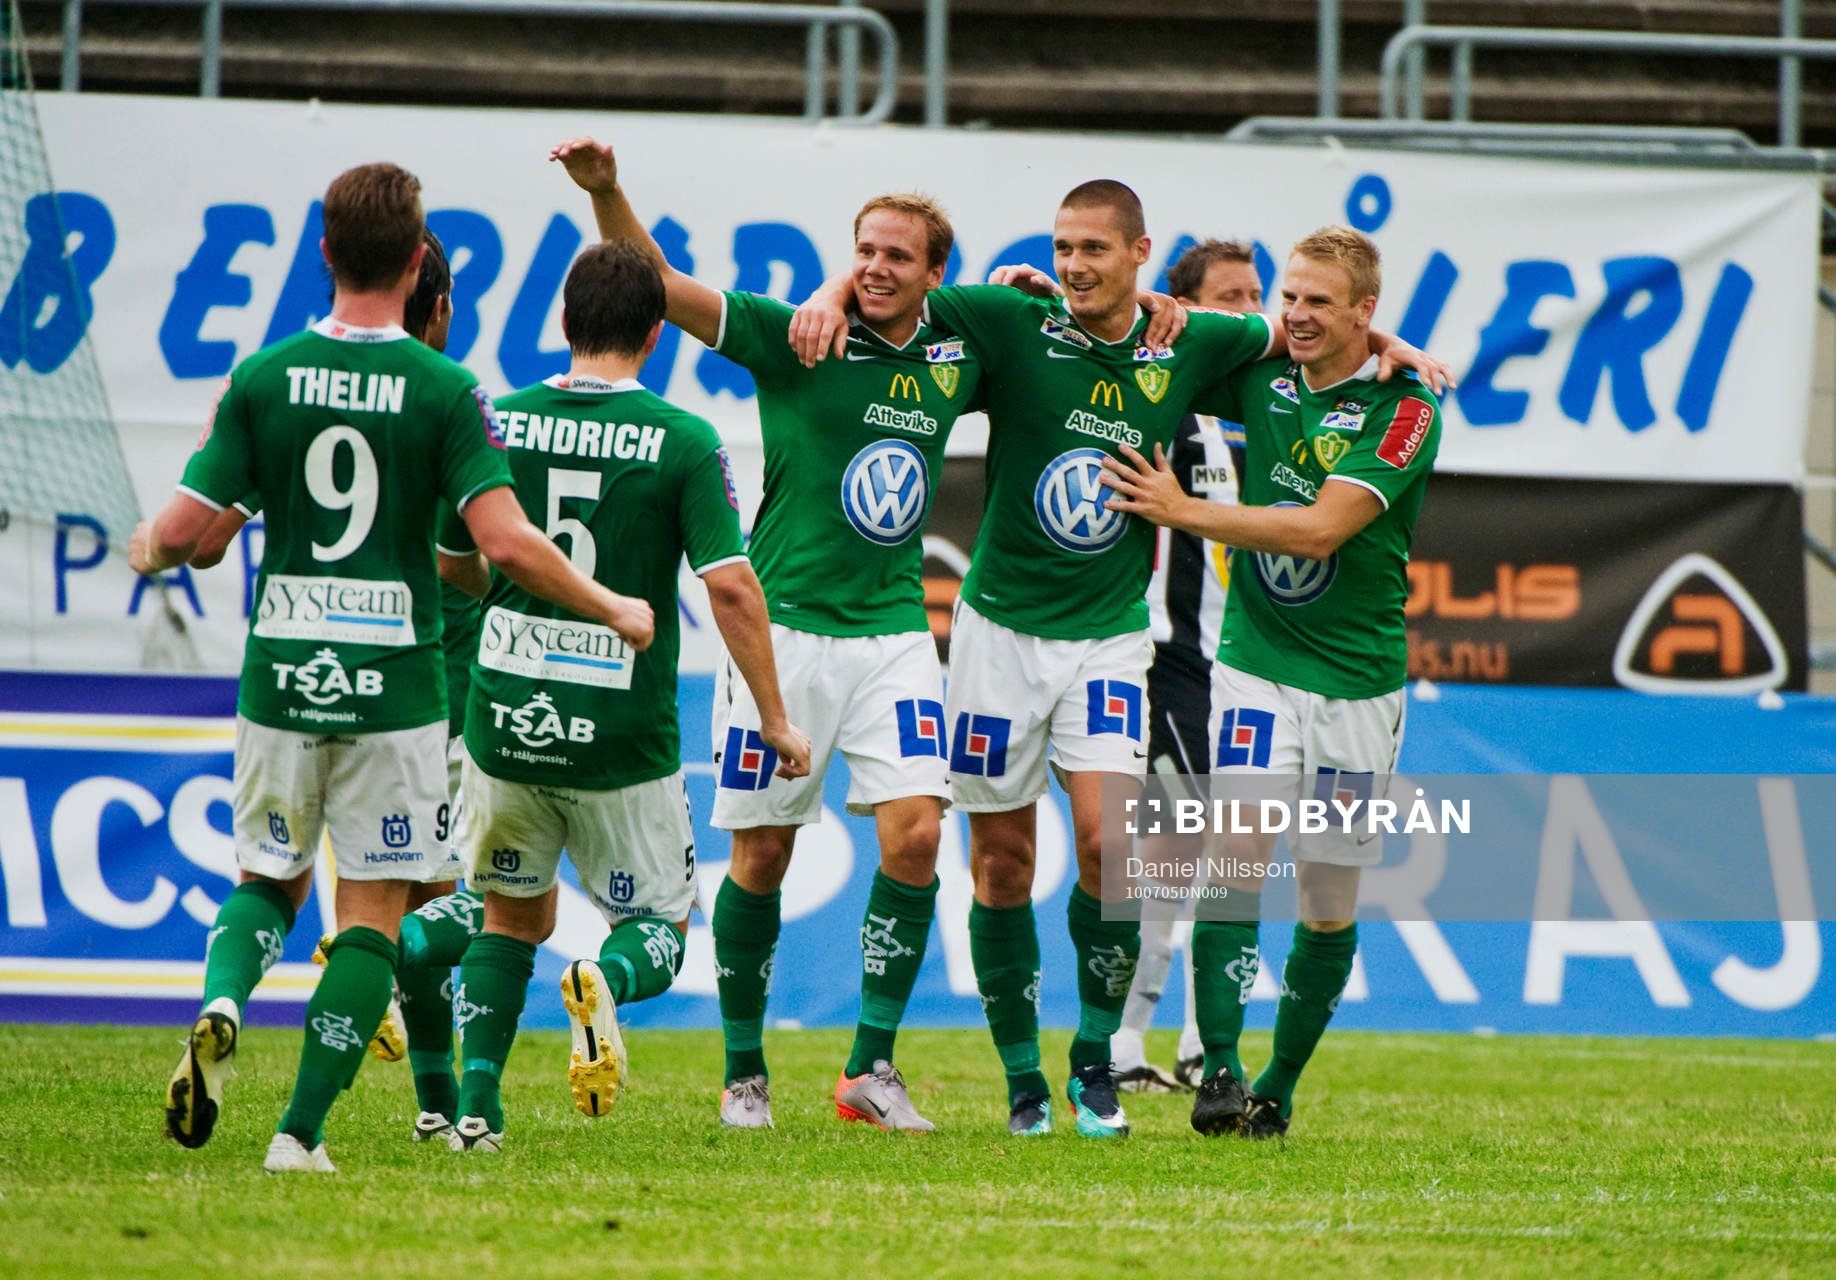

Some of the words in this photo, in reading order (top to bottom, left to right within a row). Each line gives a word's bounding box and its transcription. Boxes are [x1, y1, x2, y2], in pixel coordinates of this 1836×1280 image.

[286, 367, 406, 413] THELIN
[864, 403, 937, 435] Atteviks
[1066, 410, 1142, 448] Atteviks
[1398, 407, 1430, 463] Adecco
[304, 425, 379, 562] 9
[1194, 468, 1227, 483] MVB
[546, 467, 602, 590] 5
[272, 662, 384, 697] TSAB
[490, 702, 596, 744] TSAB
[502, 747, 513, 757] Er
[435, 802, 450, 842] 9
[473, 870, 539, 886] Husqvarna
[684, 844, 696, 882] 5
[864, 913, 898, 976] TSAB
